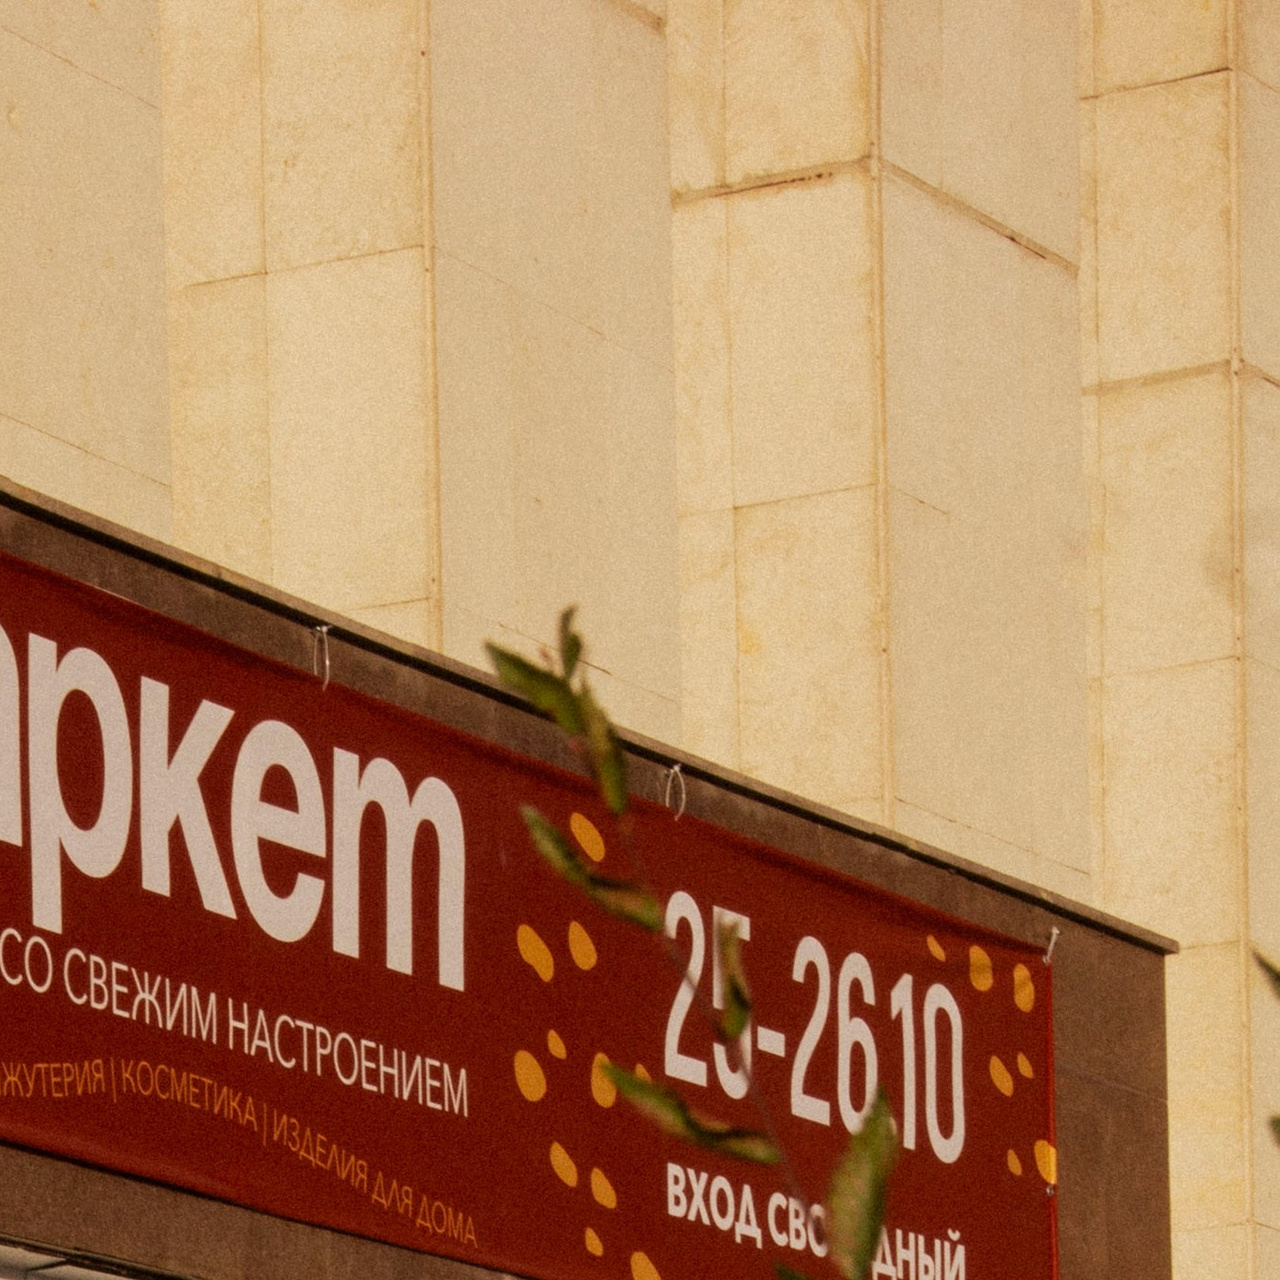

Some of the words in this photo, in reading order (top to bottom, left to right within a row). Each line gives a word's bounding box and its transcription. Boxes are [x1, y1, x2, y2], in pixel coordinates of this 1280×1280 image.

[63, 947, 218, 1046] СВЕЖИМ
[228, 997, 469, 1118] НАСТРОЕНИЕМ
[121, 1058, 259, 1132] КОСМЕТИКА
[273, 1108, 369, 1194] ИЗДЕЛИЯ
[371, 1170, 413, 1218] ДЛЯ
[416, 1193, 479, 1249] ДОМА
[666, 1161, 763, 1250] ВХОД
